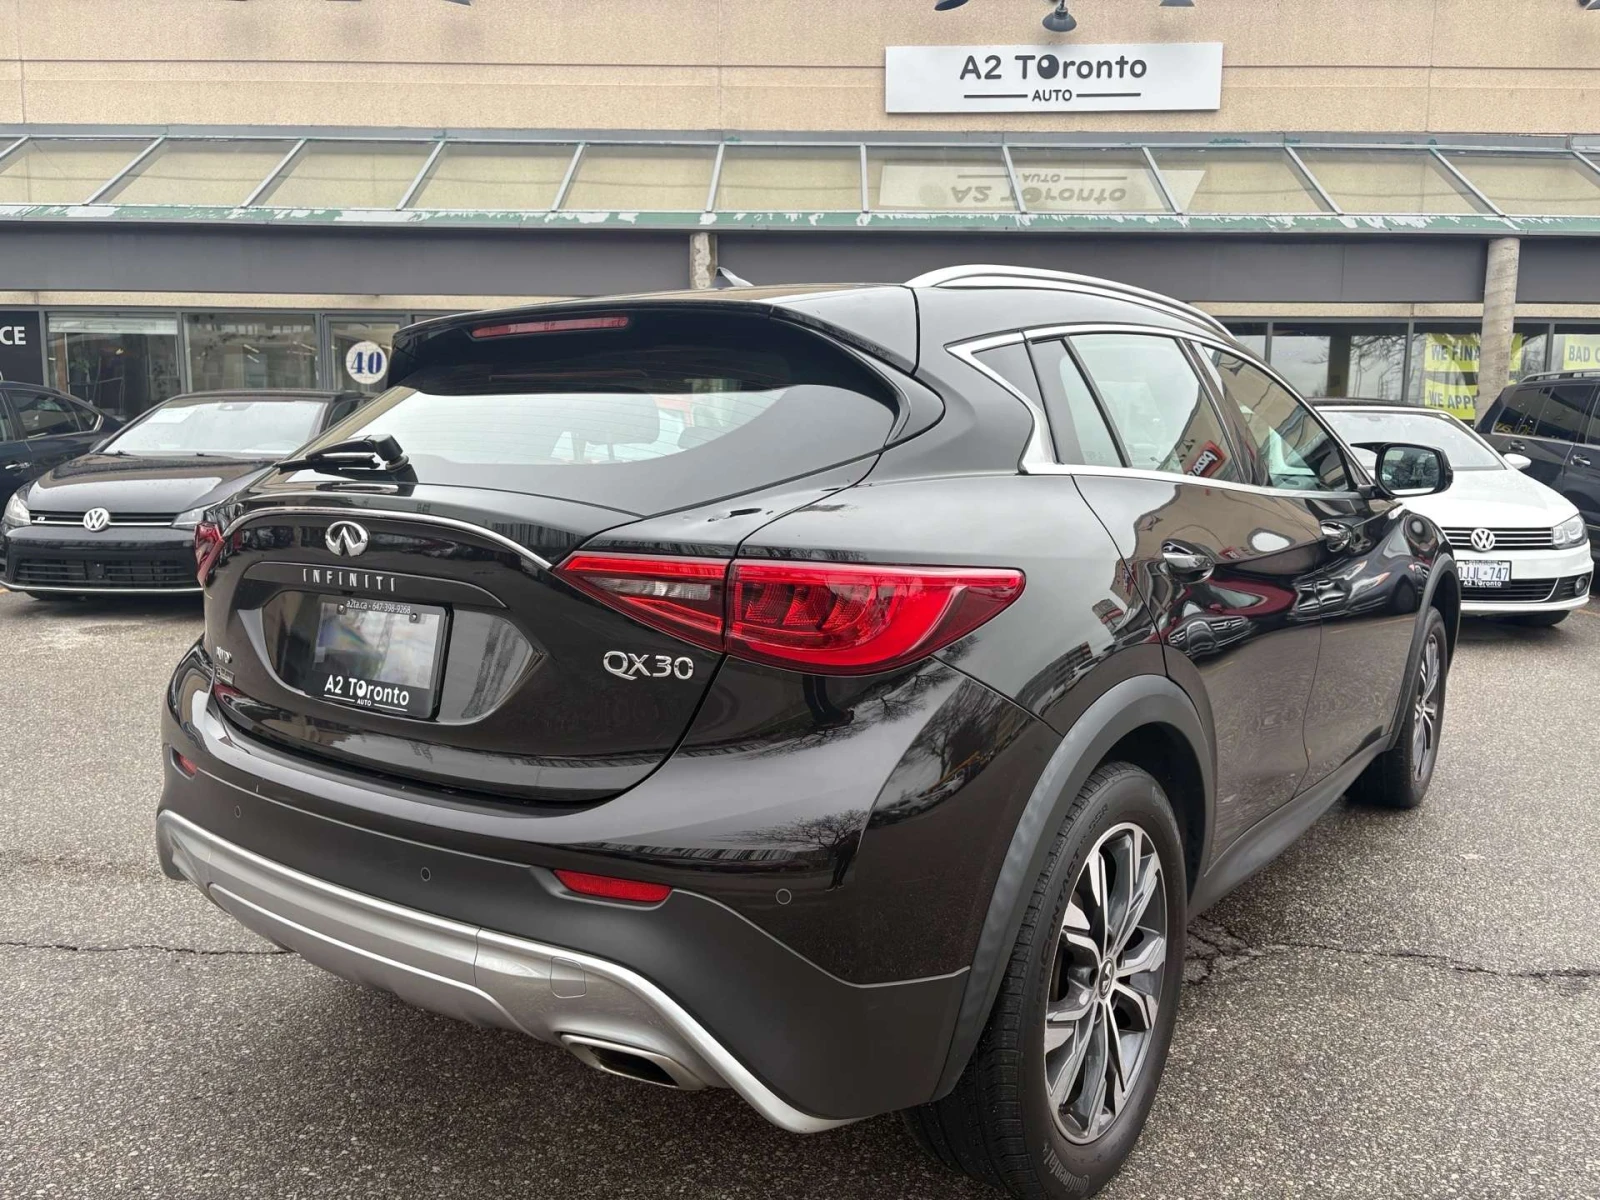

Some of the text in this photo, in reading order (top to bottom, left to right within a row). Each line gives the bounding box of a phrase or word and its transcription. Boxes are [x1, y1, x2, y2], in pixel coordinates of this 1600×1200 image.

[960, 55, 1002, 80] A2
[1032, 89, 1072, 101] AUTO
[1432, 345, 1480, 362] WE FINA
[1568, 345, 1591, 362] BAD
[351, 351, 382, 374] 40
[1429, 391, 1444, 407] WE
[303, 569, 395, 592] INFINITI
[1490, 567, 1508, 580] 747
[346, 599, 411, 614] a2ta.ca 647-398-9268
[603, 650, 694, 680] QX30
[324, 674, 344, 694] A2
[357, 698, 372, 706] AUTO
